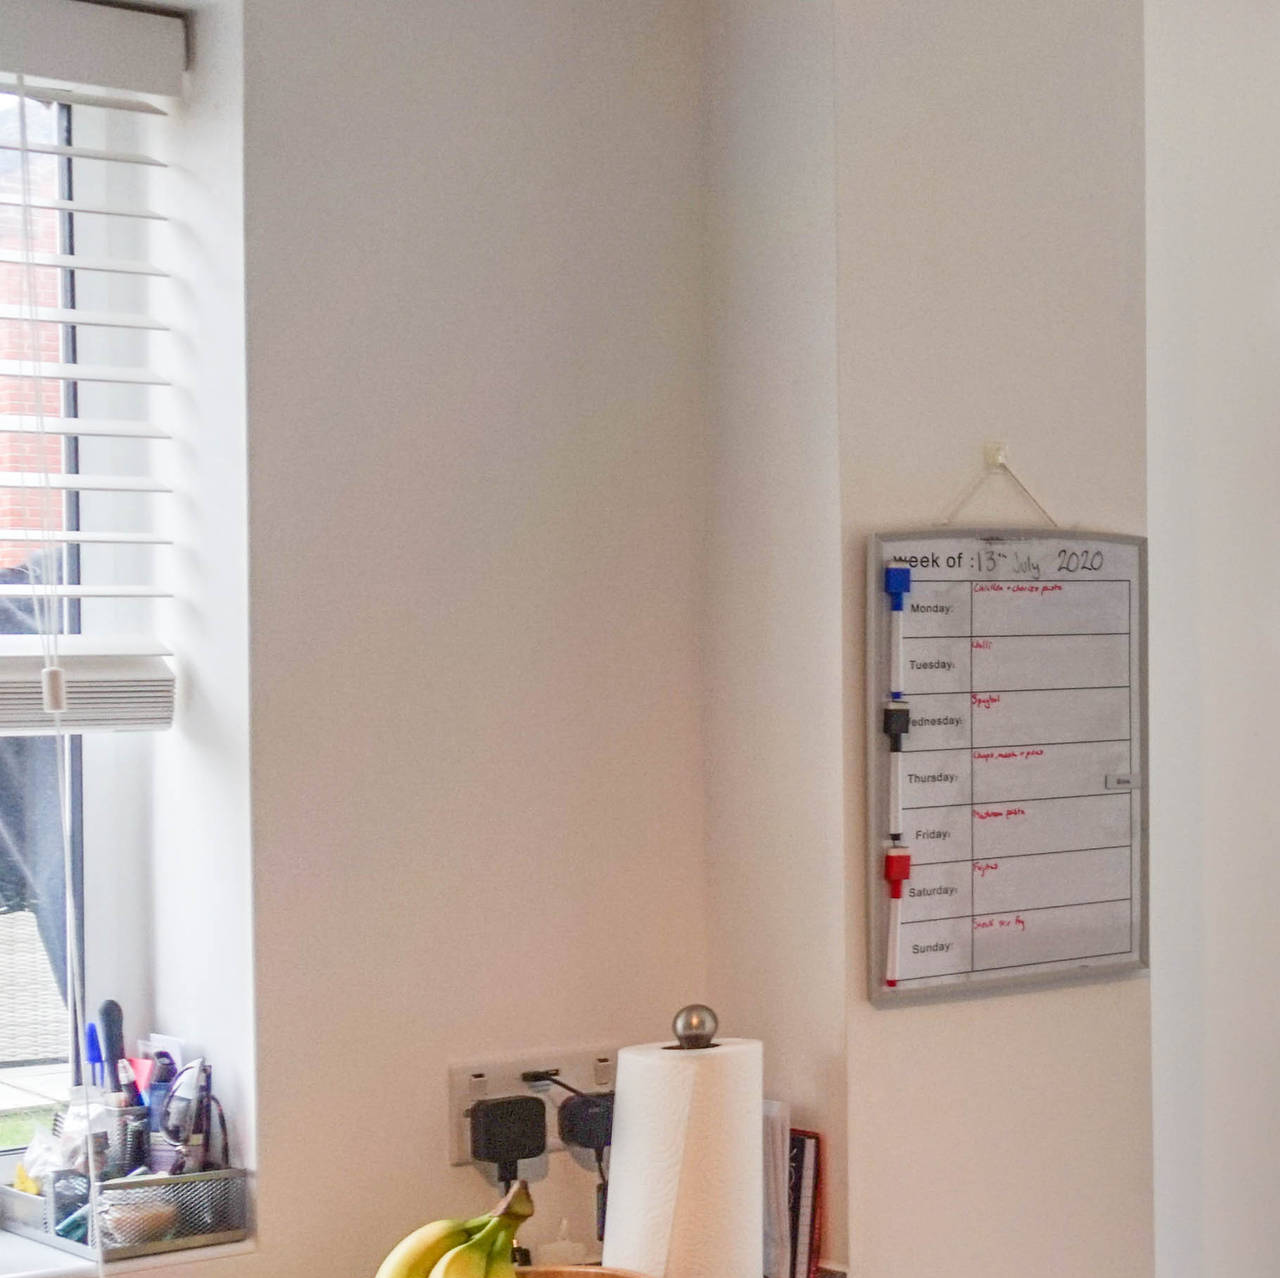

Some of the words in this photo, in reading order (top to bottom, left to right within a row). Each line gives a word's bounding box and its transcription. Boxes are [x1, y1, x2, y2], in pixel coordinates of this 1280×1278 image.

[1013, 551, 1040, 579] July
[1057, 549, 1104, 572] 2020
[908, 715, 963, 727] ednesday:
